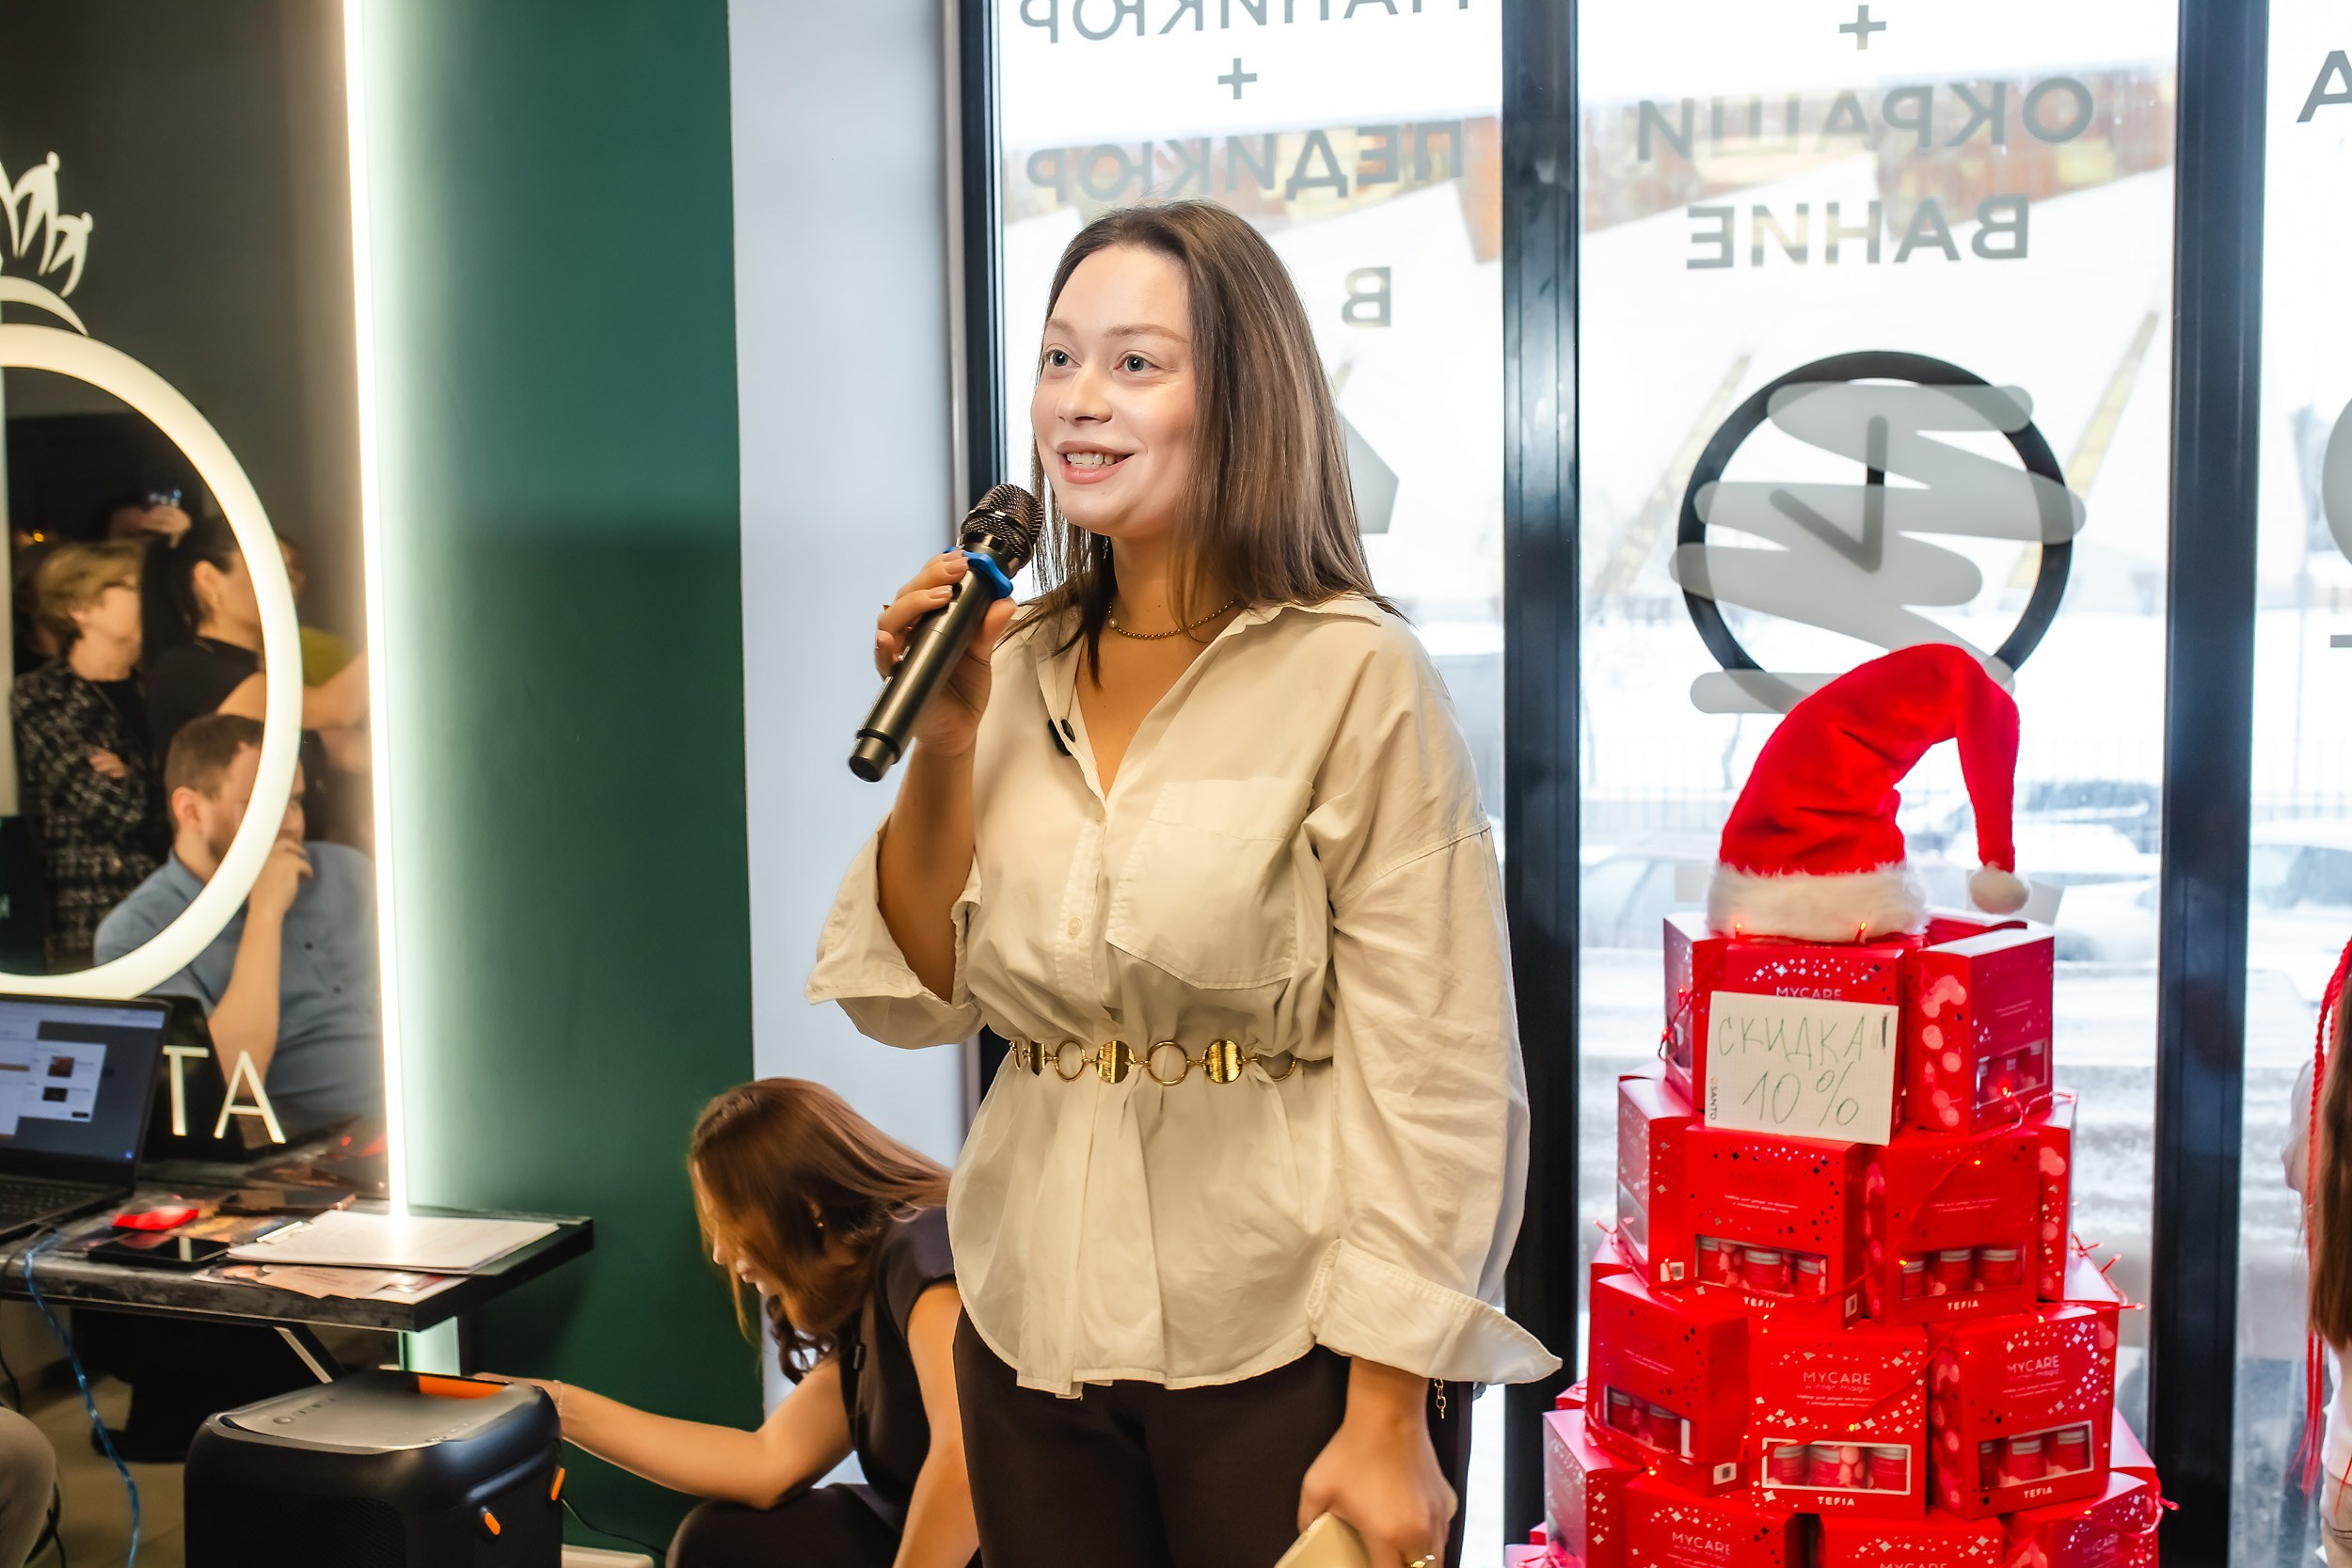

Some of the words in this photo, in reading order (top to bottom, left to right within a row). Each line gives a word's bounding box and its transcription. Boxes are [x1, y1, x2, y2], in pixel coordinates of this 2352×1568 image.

[1776, 986, 1842, 1002] MYCARE
[1947, 1300, 1979, 1311] TEFIA
[2007, 1354, 2059, 1373] MYCARE
[1803, 1370, 1871, 1386] MYCARE
[2024, 1486, 2053, 1498] TEFIA
[1817, 1497, 1855, 1506] TEFIA
[1672, 1531, 1731, 1556] MYCARE
